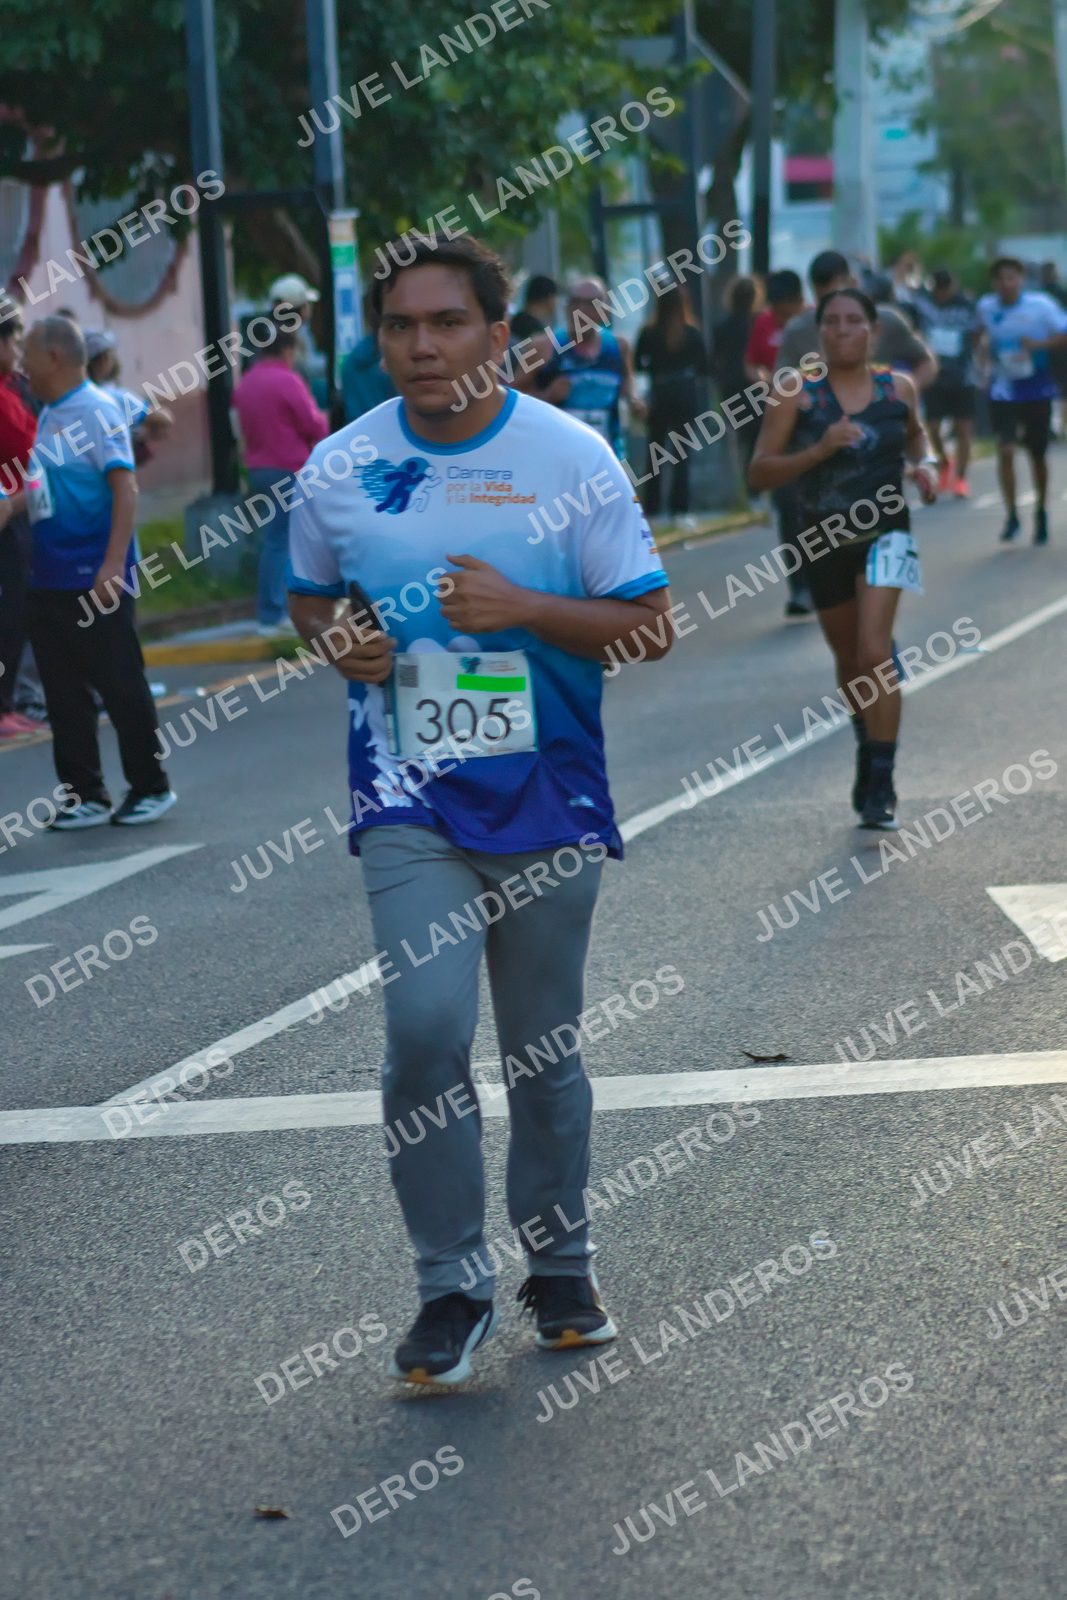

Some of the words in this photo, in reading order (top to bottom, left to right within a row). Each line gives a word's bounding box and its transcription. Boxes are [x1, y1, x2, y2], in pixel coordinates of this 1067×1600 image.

[446, 465, 513, 481] Carrera
[483, 481, 513, 492] Vida
[469, 493, 537, 506] Integridad
[415, 697, 511, 745] 305
